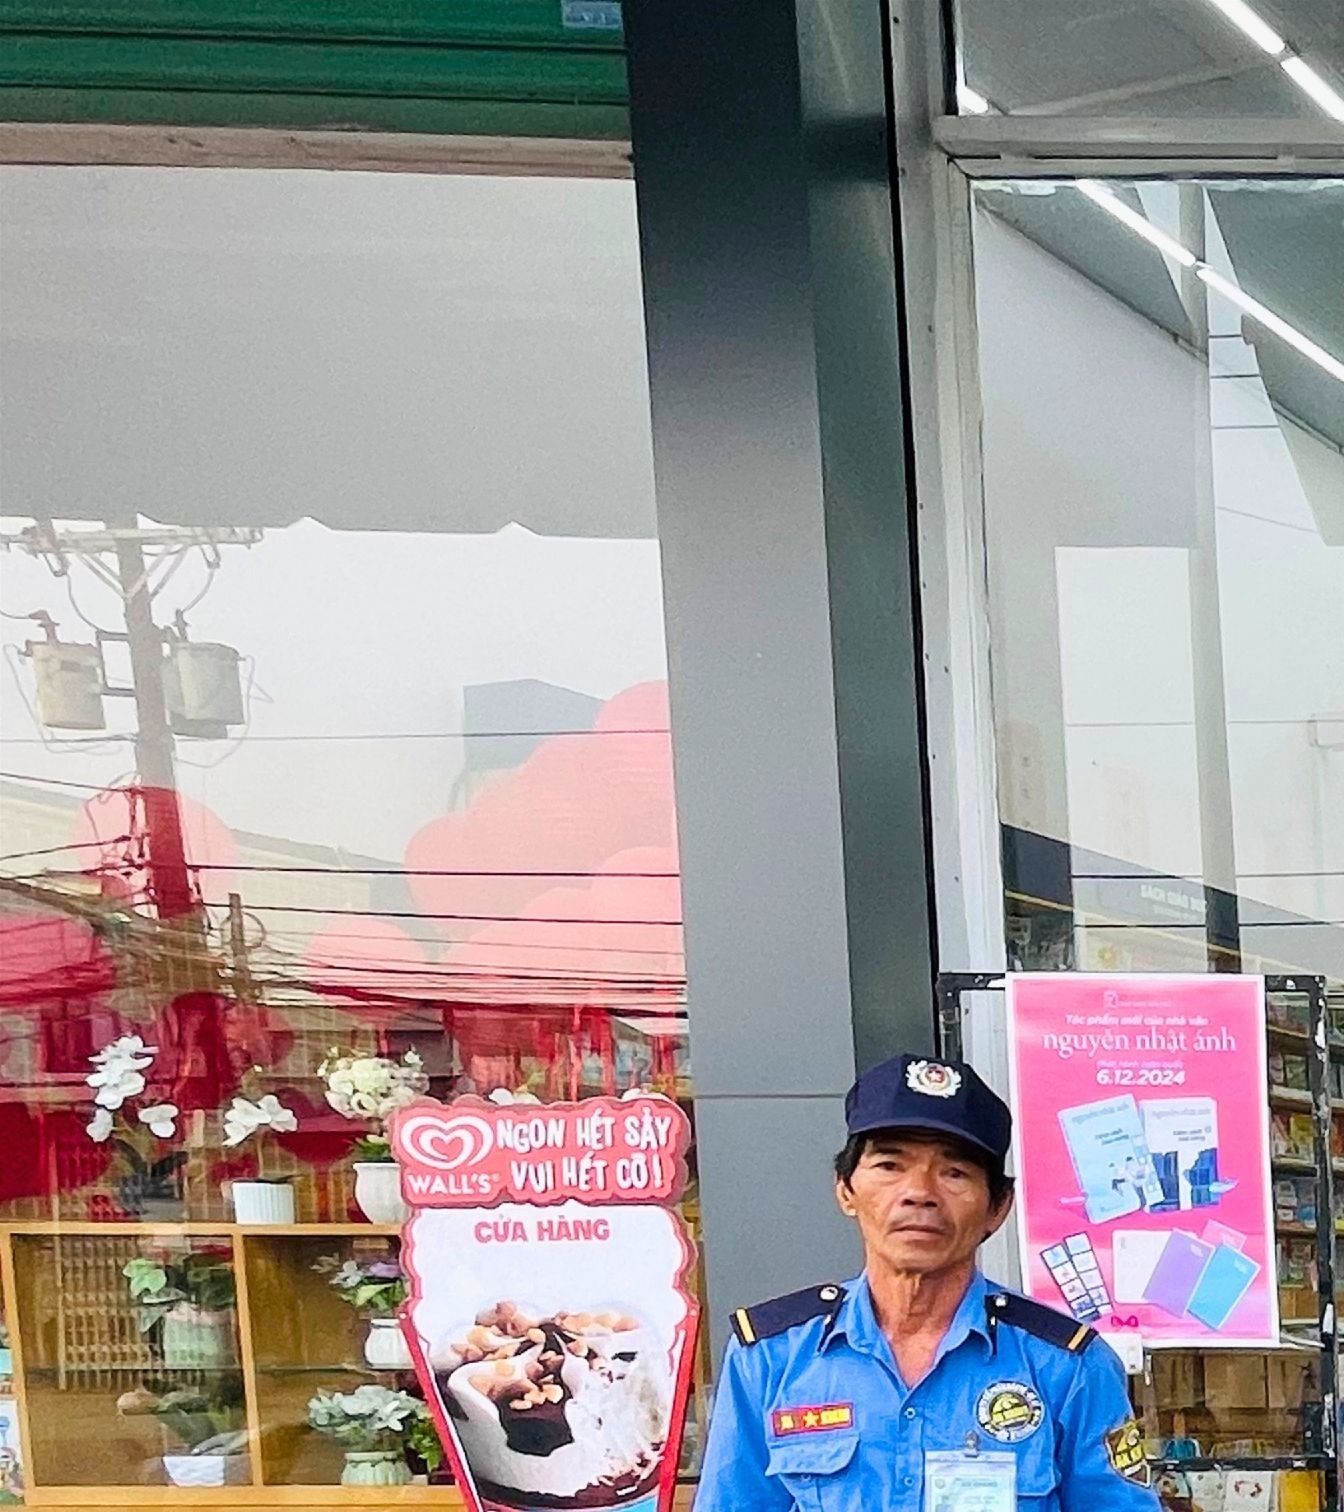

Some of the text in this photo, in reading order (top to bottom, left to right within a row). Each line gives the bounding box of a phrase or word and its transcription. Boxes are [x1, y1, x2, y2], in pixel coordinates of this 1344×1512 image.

[1043, 1026, 1236, 1059] nguyễn nhật ánh
[1096, 1069, 1186, 1086] 6.12.2024
[497, 1118, 565, 1152] NGON
[408, 1173, 493, 1196] WALL'S
[511, 1160, 555, 1194] VUI
[474, 1212, 610, 1243] CỬA HÀNG
